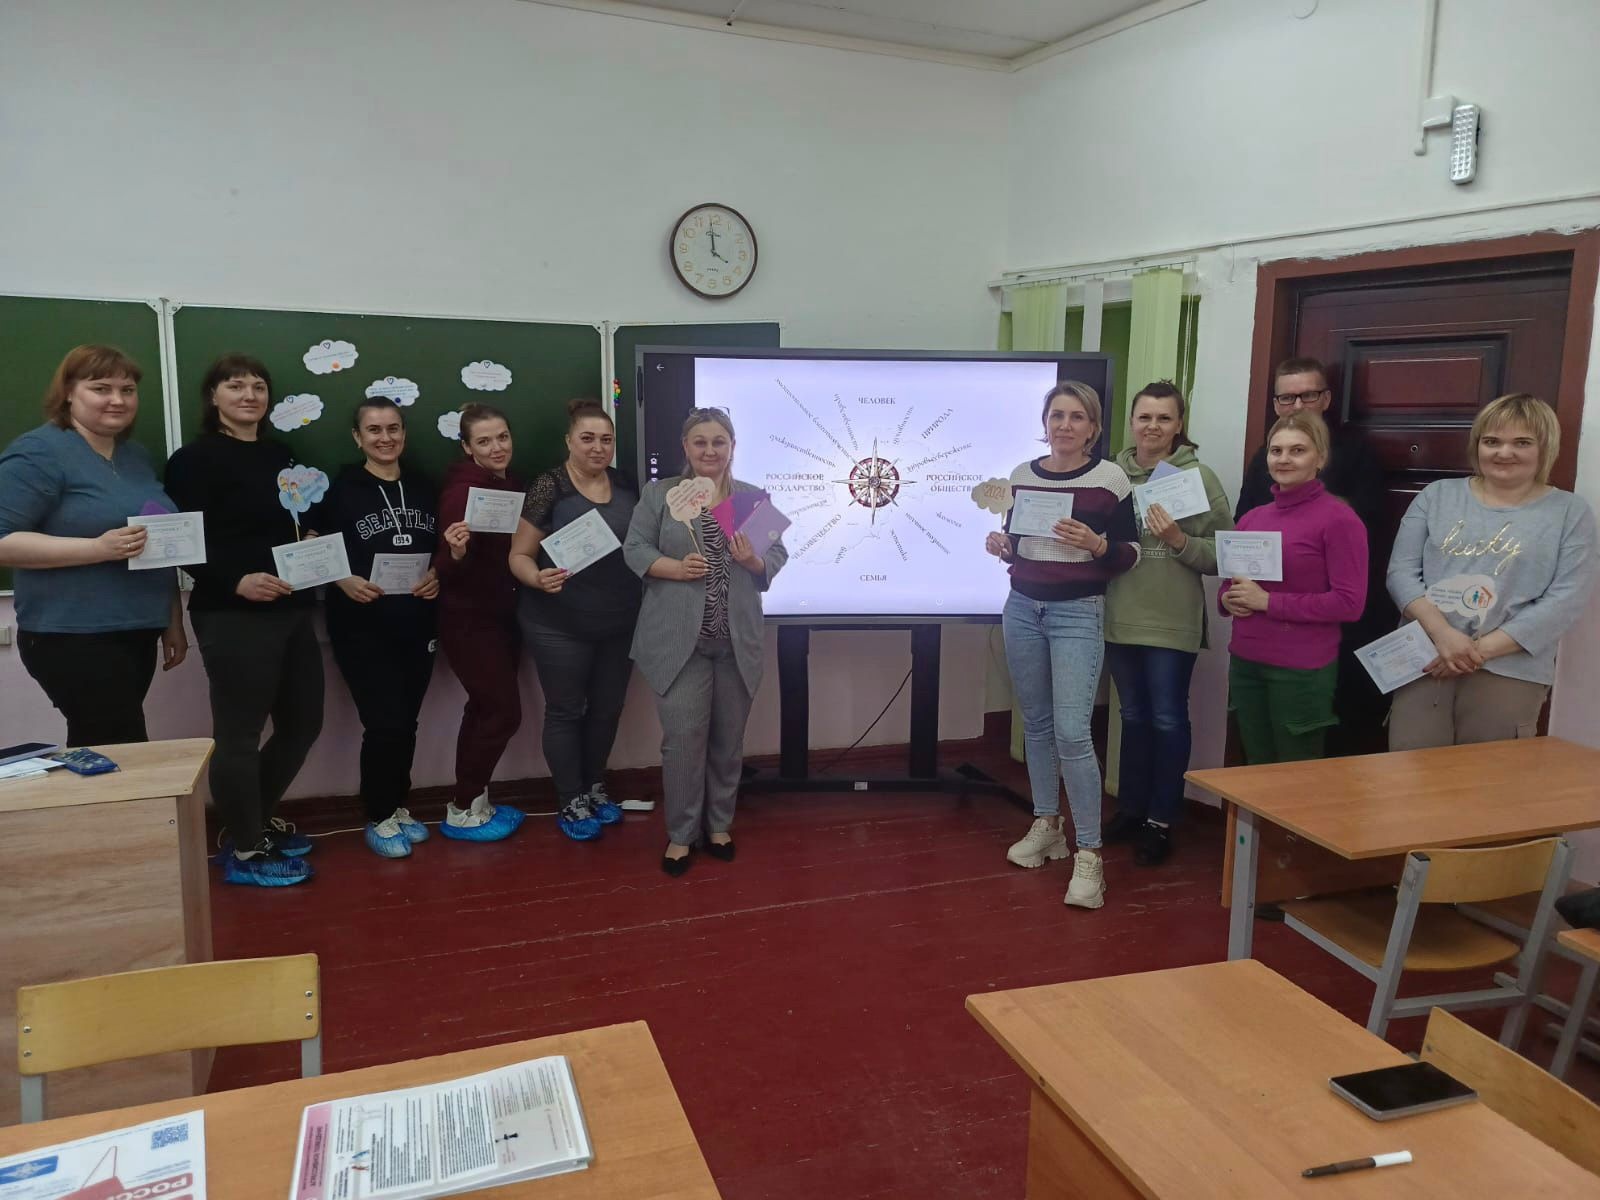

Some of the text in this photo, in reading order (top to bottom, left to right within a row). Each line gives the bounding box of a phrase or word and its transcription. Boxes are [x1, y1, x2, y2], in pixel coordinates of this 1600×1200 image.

[679, 242, 689, 254] 9
[857, 396, 896, 406] ЧЕЛОВЕК
[921, 408, 953, 440] ПРИРОДА
[765, 472, 825, 481] РОССИЙСКОЕ
[926, 473, 984, 482] РОССИЙСКОЕ
[930, 484, 974, 494] ОБЩЕСТВ
[983, 484, 1006, 500] 2024
[356, 508, 435, 540] SEATTLE
[791, 513, 843, 560] ЧЕЛОВЕЧЕСТВО
[859, 573, 888, 582] СЕМЬЯ
